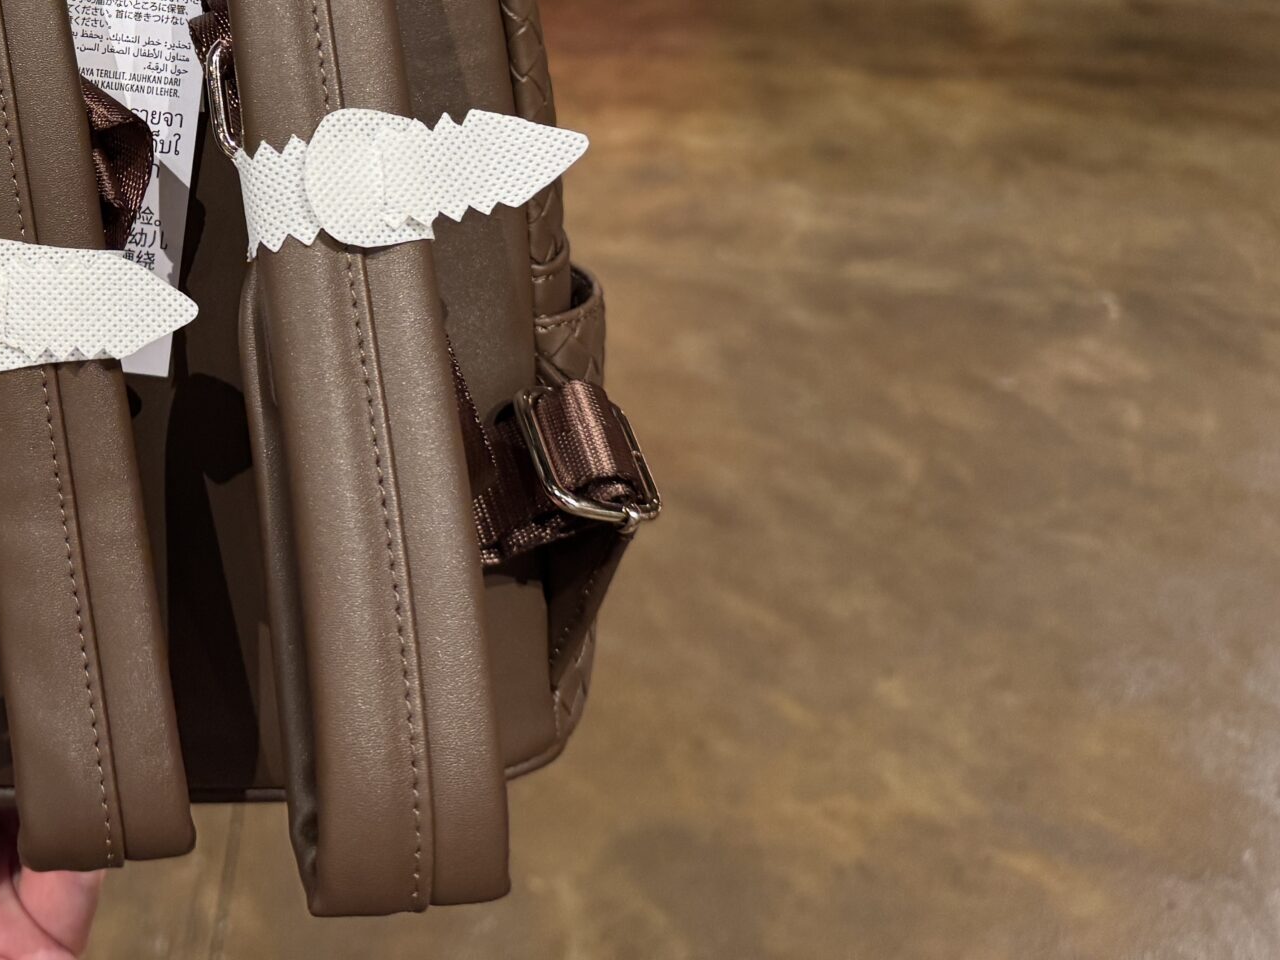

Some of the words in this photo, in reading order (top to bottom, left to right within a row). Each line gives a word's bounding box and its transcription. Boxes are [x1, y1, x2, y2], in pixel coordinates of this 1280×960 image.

[79, 66, 94, 77] AYA
[96, 68, 127, 81] TERLILIT.
[128, 73, 162, 85] JAUHKAN
[163, 77, 181, 87] DARI
[101, 81, 145, 94] KALUNGKAN
[146, 86, 155, 95] DI
[155, 87, 180, 98] LEHER.
